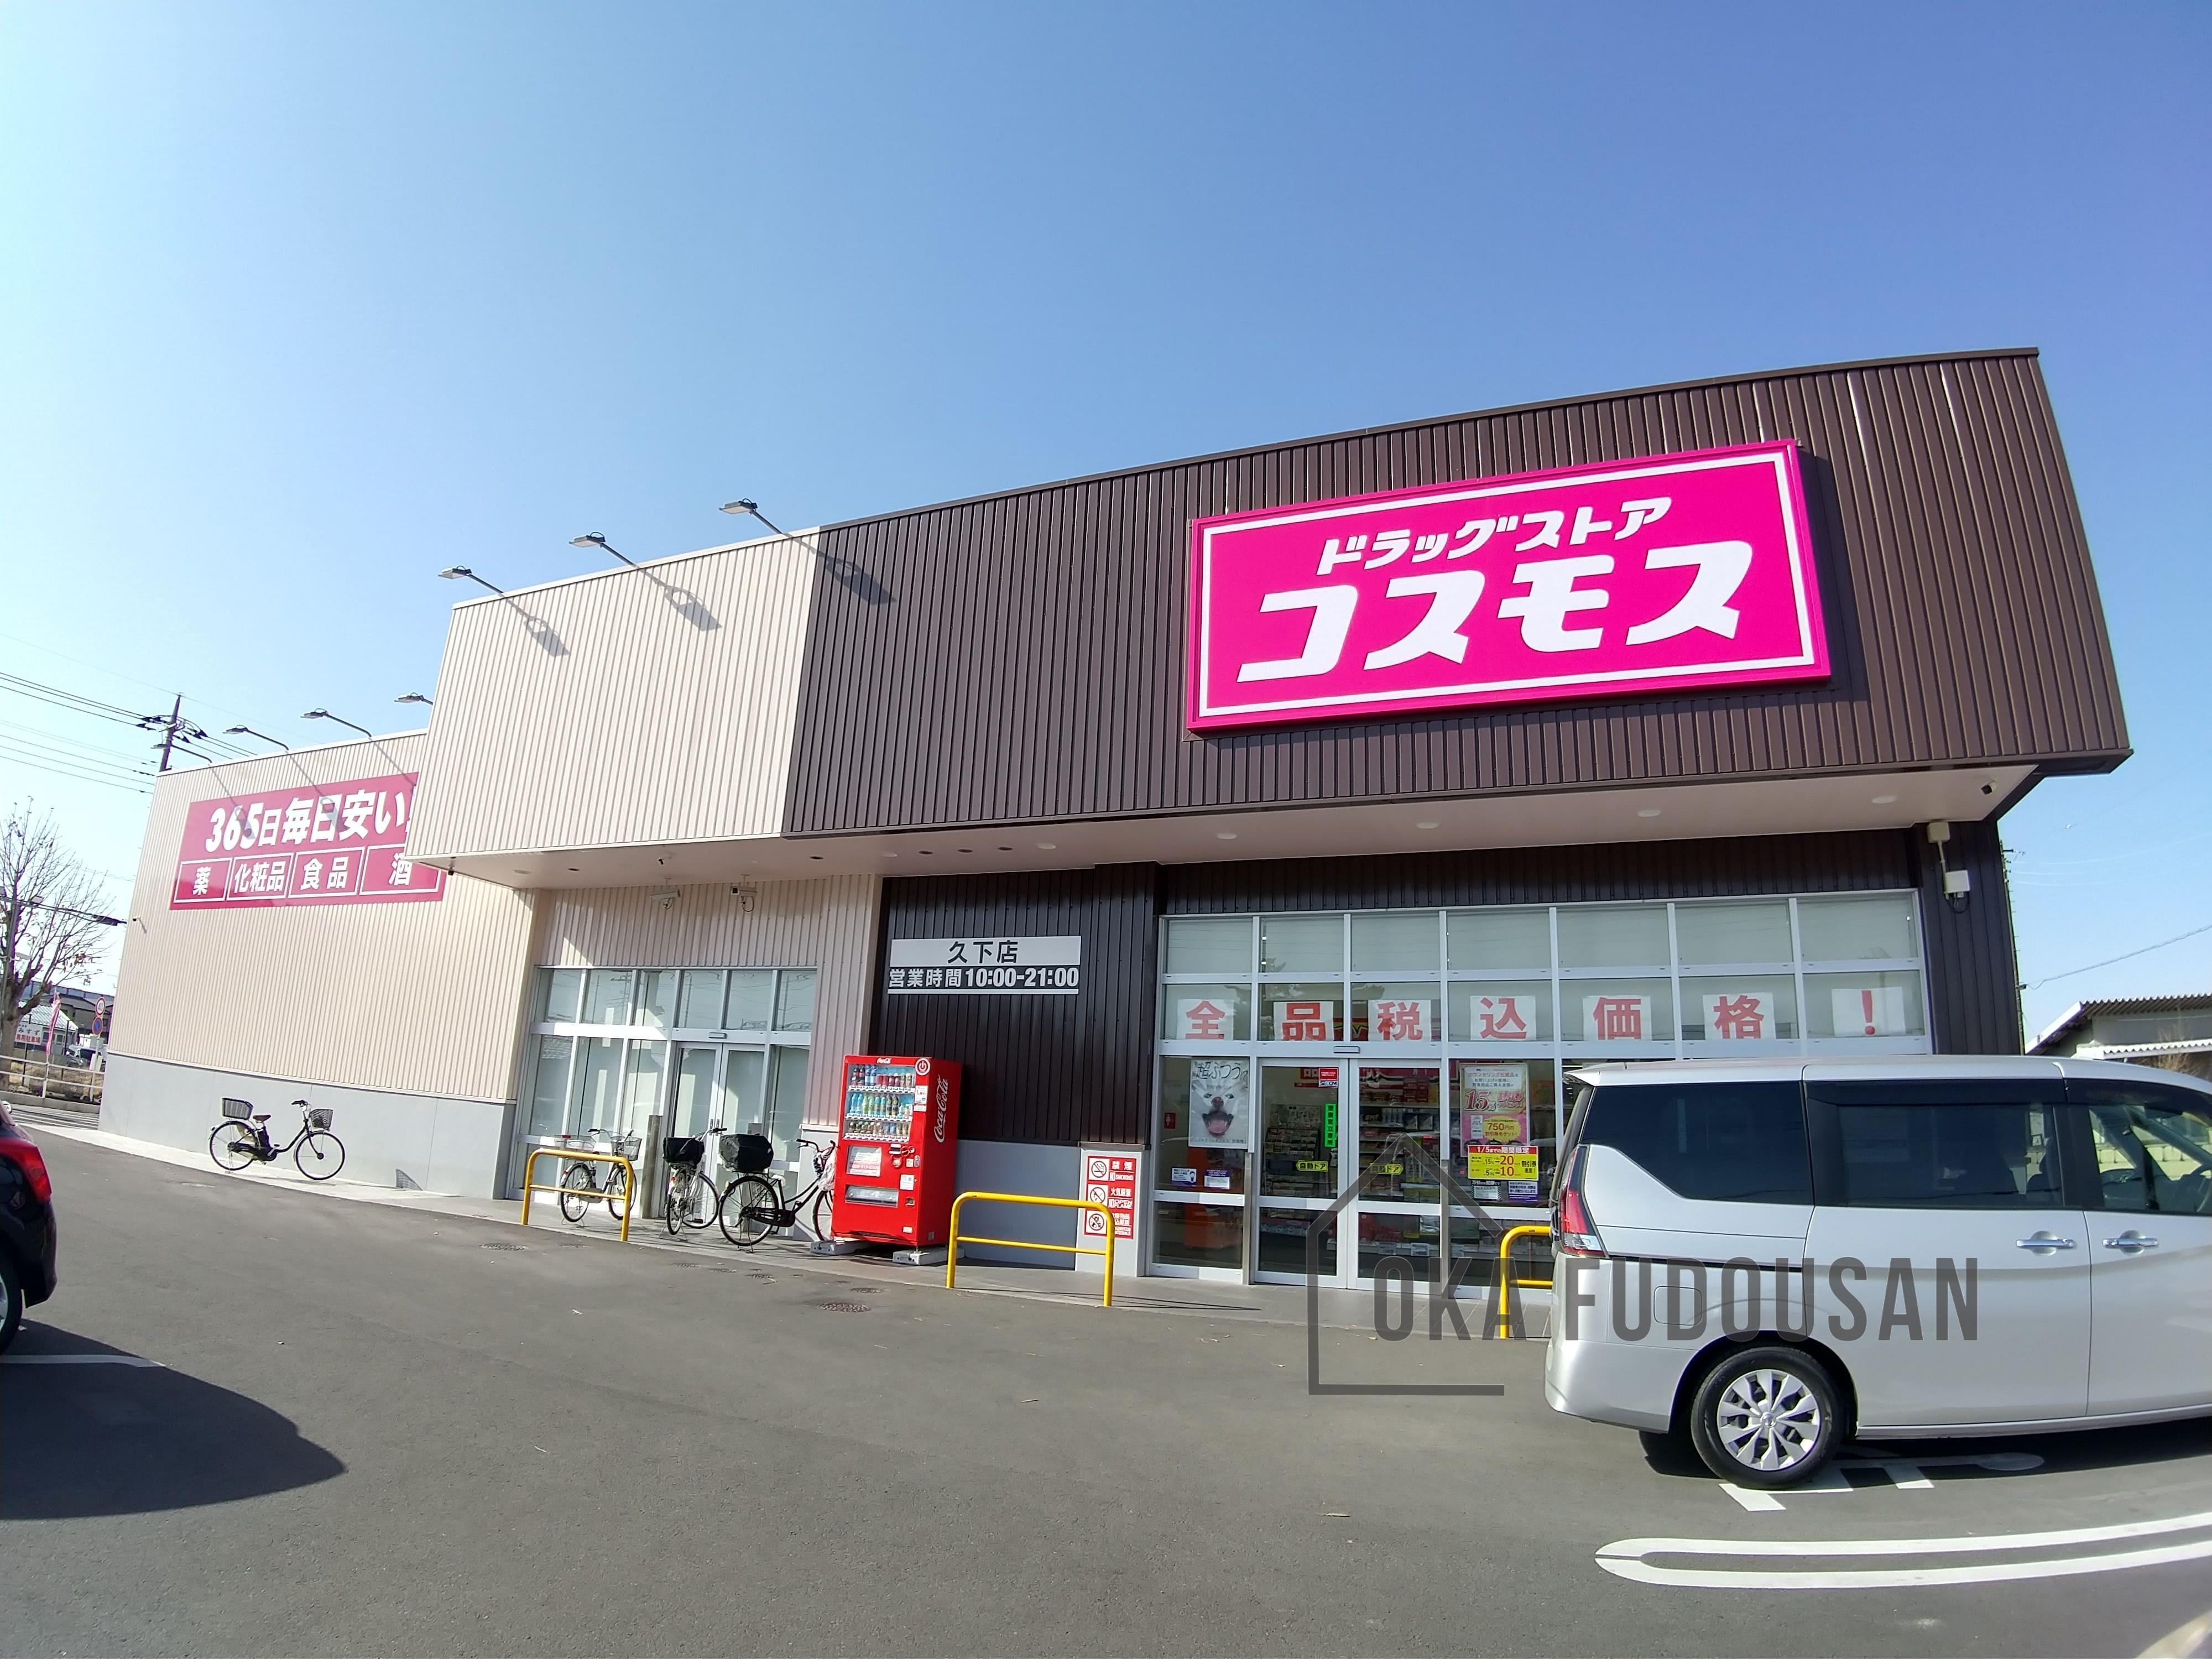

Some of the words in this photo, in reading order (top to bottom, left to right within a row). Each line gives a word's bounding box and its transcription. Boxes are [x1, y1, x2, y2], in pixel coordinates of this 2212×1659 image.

[1316, 497, 1672, 576] ドラッグストア
[1236, 541, 1754, 683] コスモス
[205, 785, 415, 853] 365日毎日安い
[192, 867, 211, 896] 薬
[234, 862, 284, 893] 化粧品
[388, 853, 413, 886] 酒
[947, 940, 1019, 964] 久下店
[934, 1073, 948, 1143] Coca-Cola
